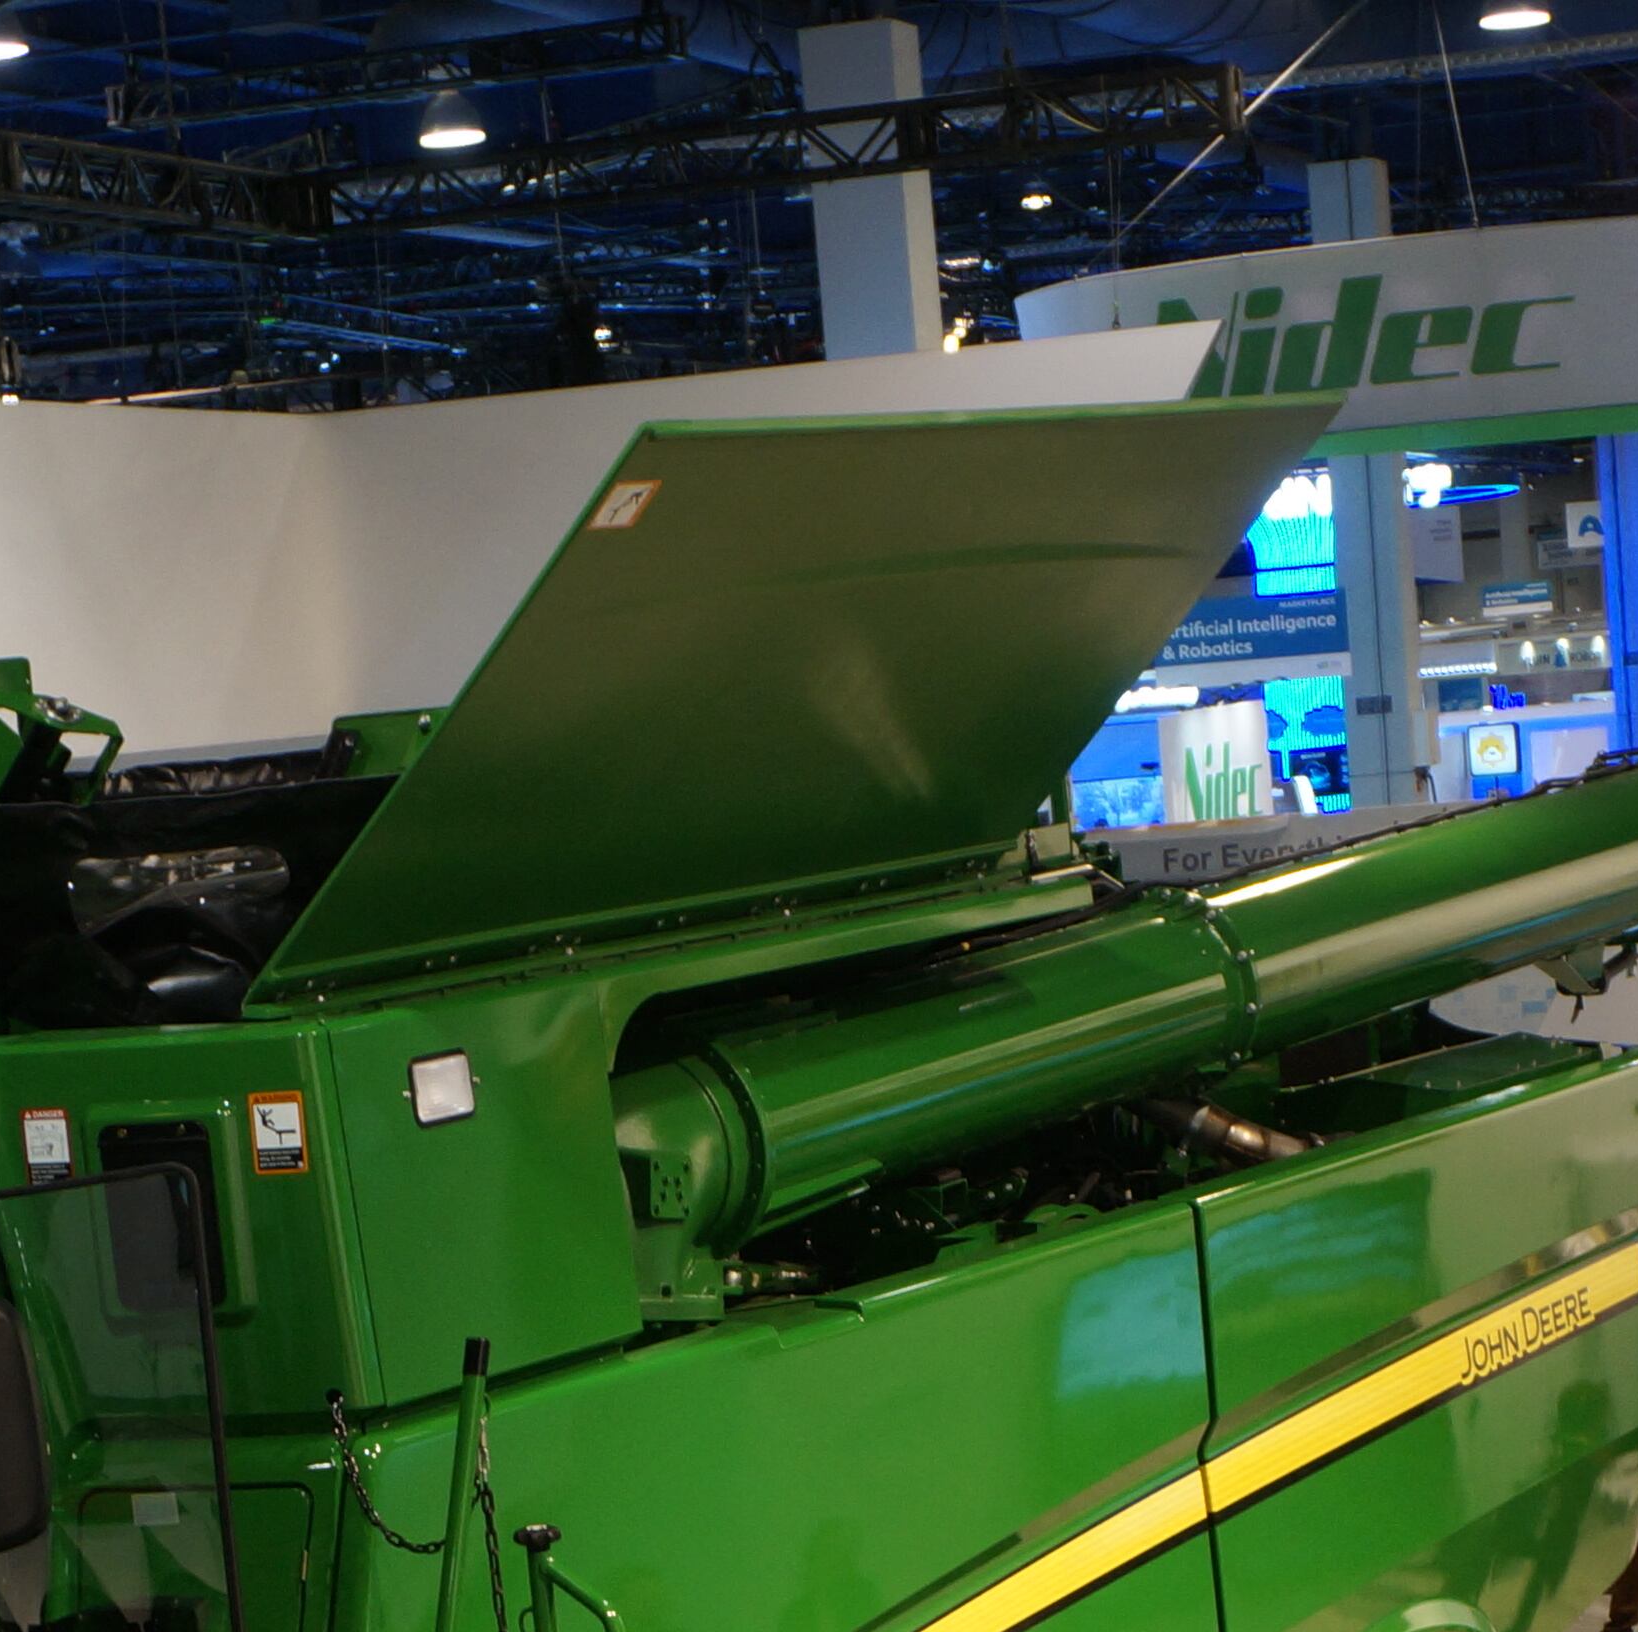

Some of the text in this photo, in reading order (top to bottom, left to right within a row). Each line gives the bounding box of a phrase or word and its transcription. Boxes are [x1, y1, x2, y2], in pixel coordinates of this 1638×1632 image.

[1170, 614, 1337, 639] rtificial Intelligence
[1163, 640, 1253, 661] & Robotics
[1185, 742, 1263, 822] Nidec
[1163, 847, 1208, 873] For
[32, 1109, 64, 1119] DANGER
[1461, 1286, 1592, 1380] JOHN DEERE
